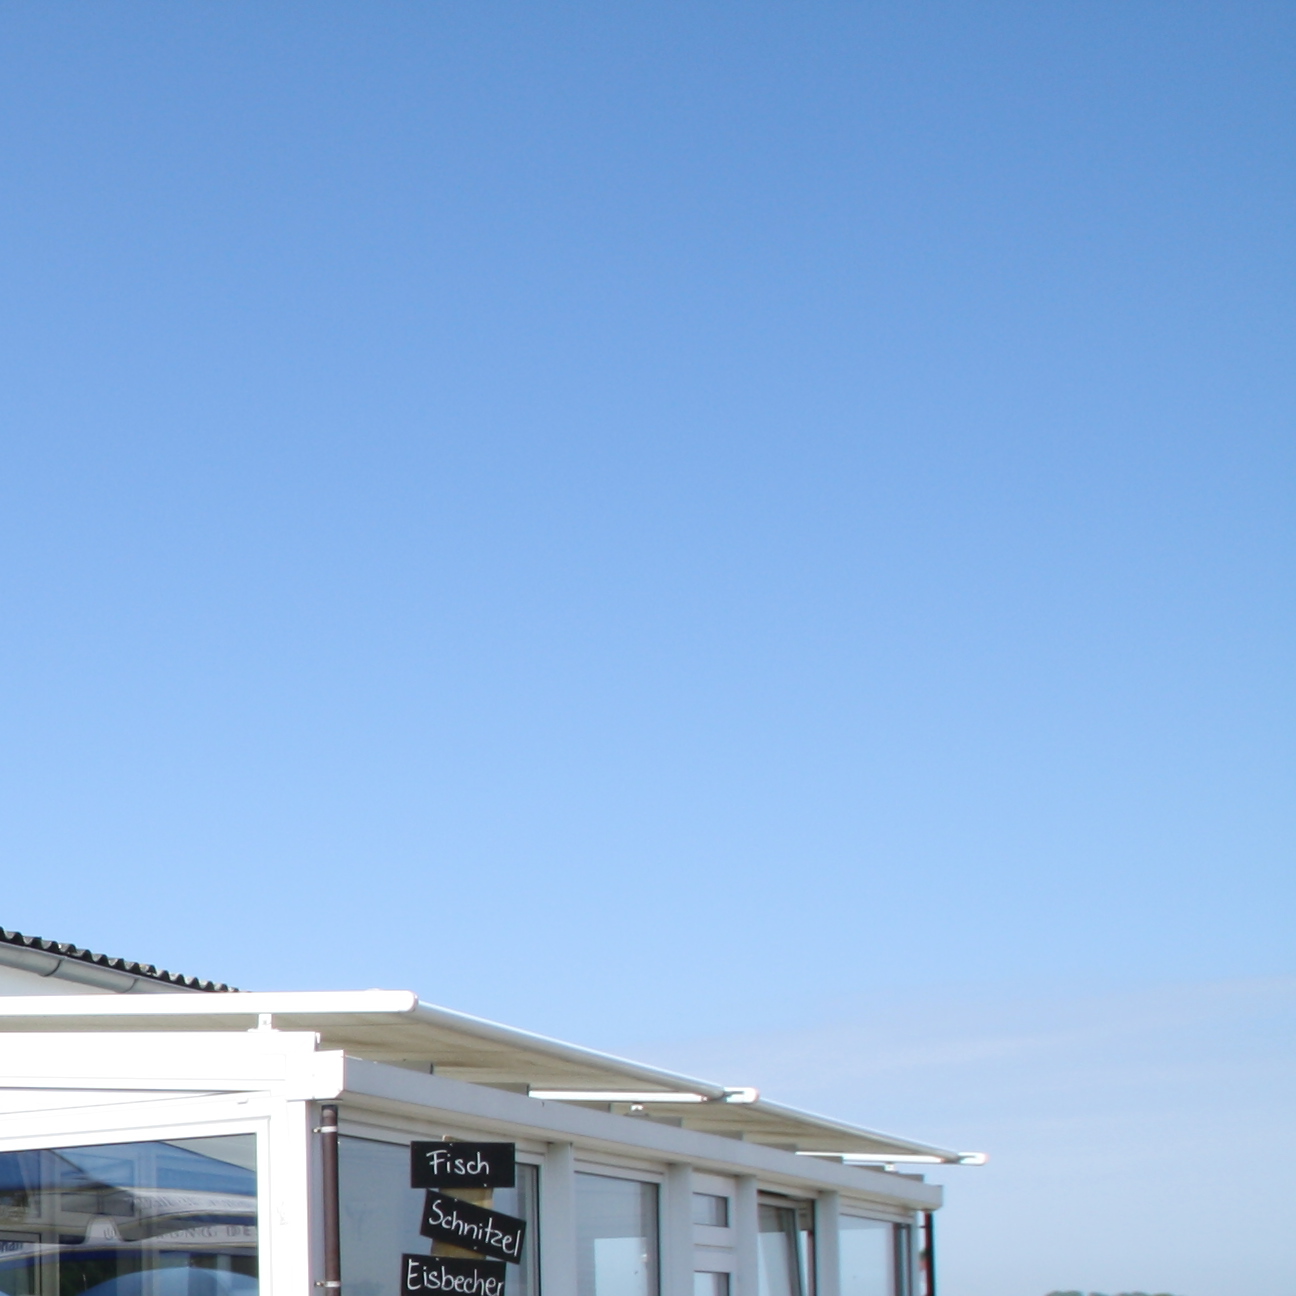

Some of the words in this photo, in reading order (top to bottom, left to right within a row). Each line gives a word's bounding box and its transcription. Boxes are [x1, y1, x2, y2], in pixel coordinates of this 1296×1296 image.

[426, 1149, 490, 1176] Fisch
[428, 1199, 521, 1257] Schnitzel
[406, 1259, 504, 1296] Eisbecher
